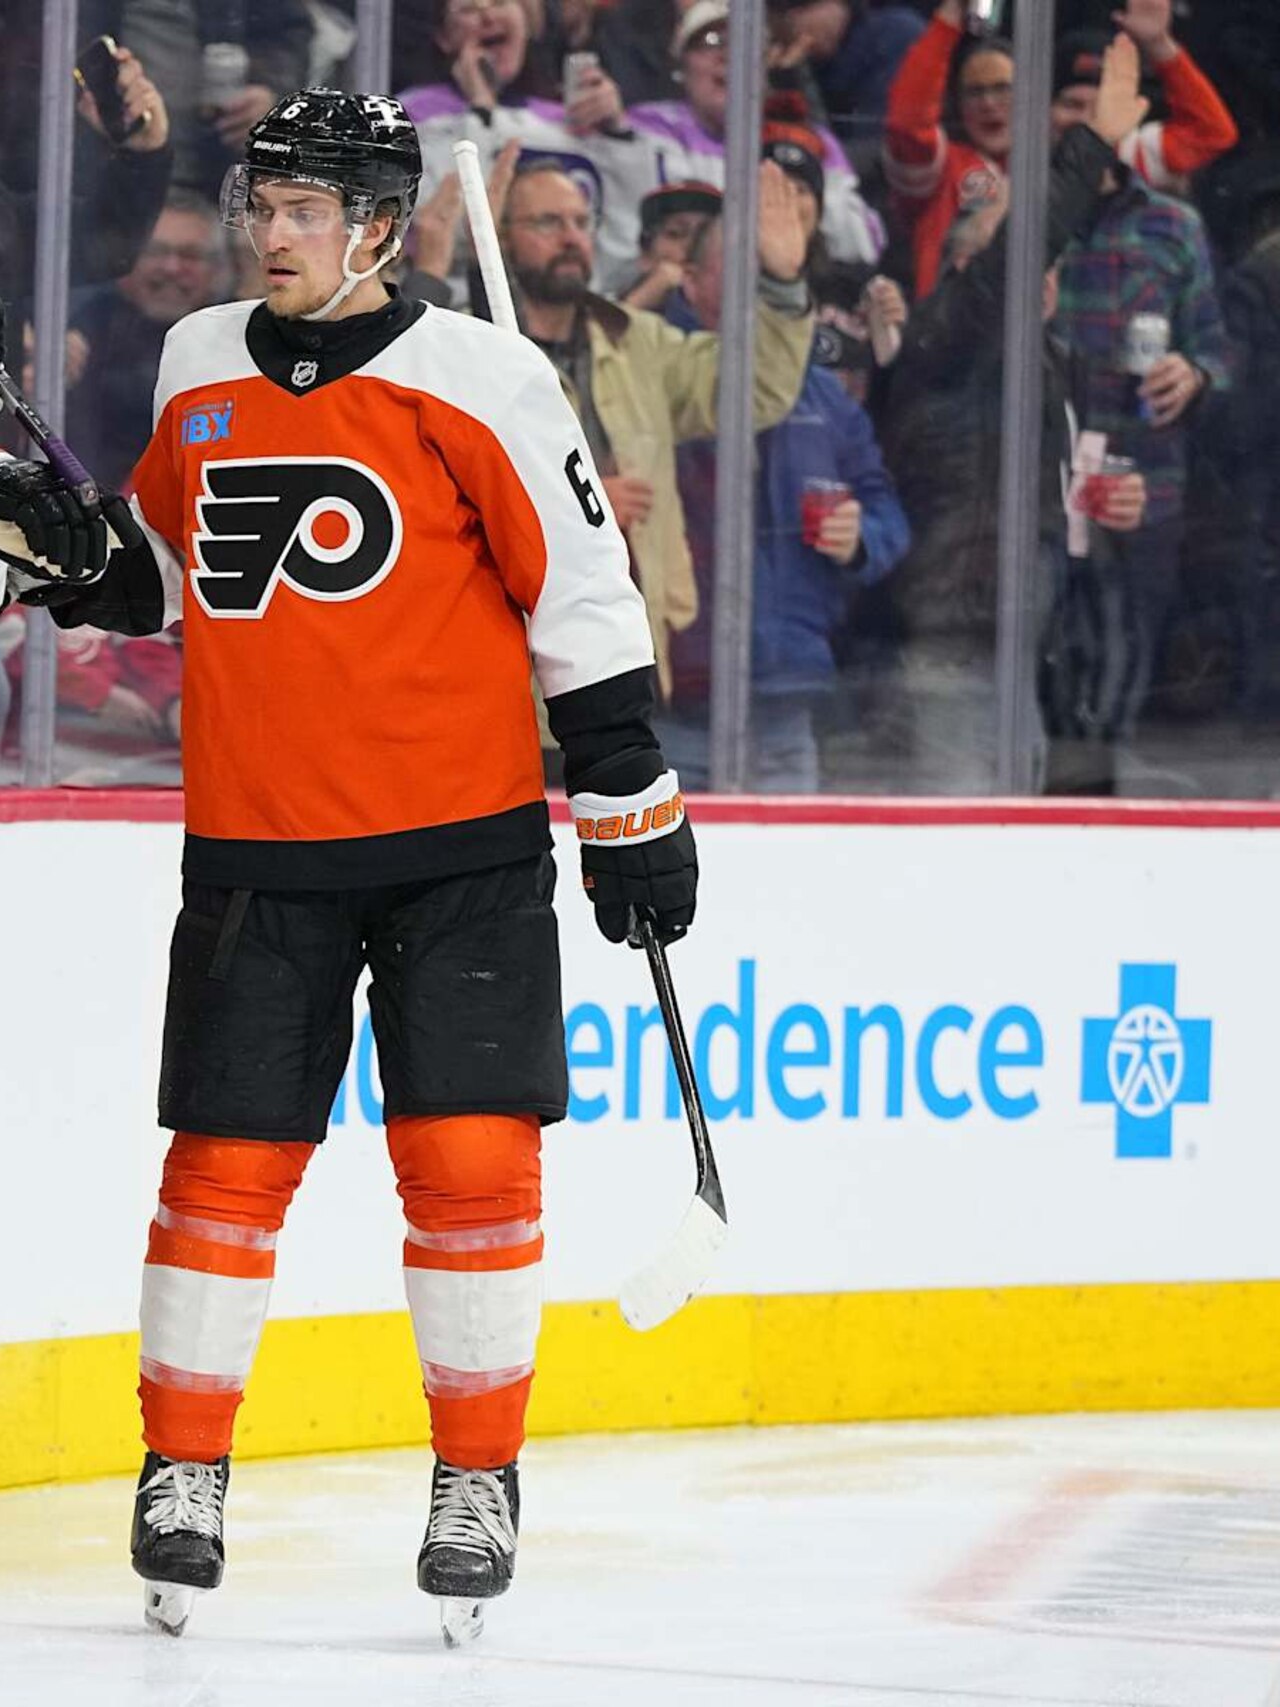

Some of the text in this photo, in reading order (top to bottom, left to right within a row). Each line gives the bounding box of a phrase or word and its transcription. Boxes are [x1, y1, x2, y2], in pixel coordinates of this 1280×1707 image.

[280, 101, 309, 120] 6
[563, 447, 606, 528] 6
[330, 960, 1044, 1121] endence
